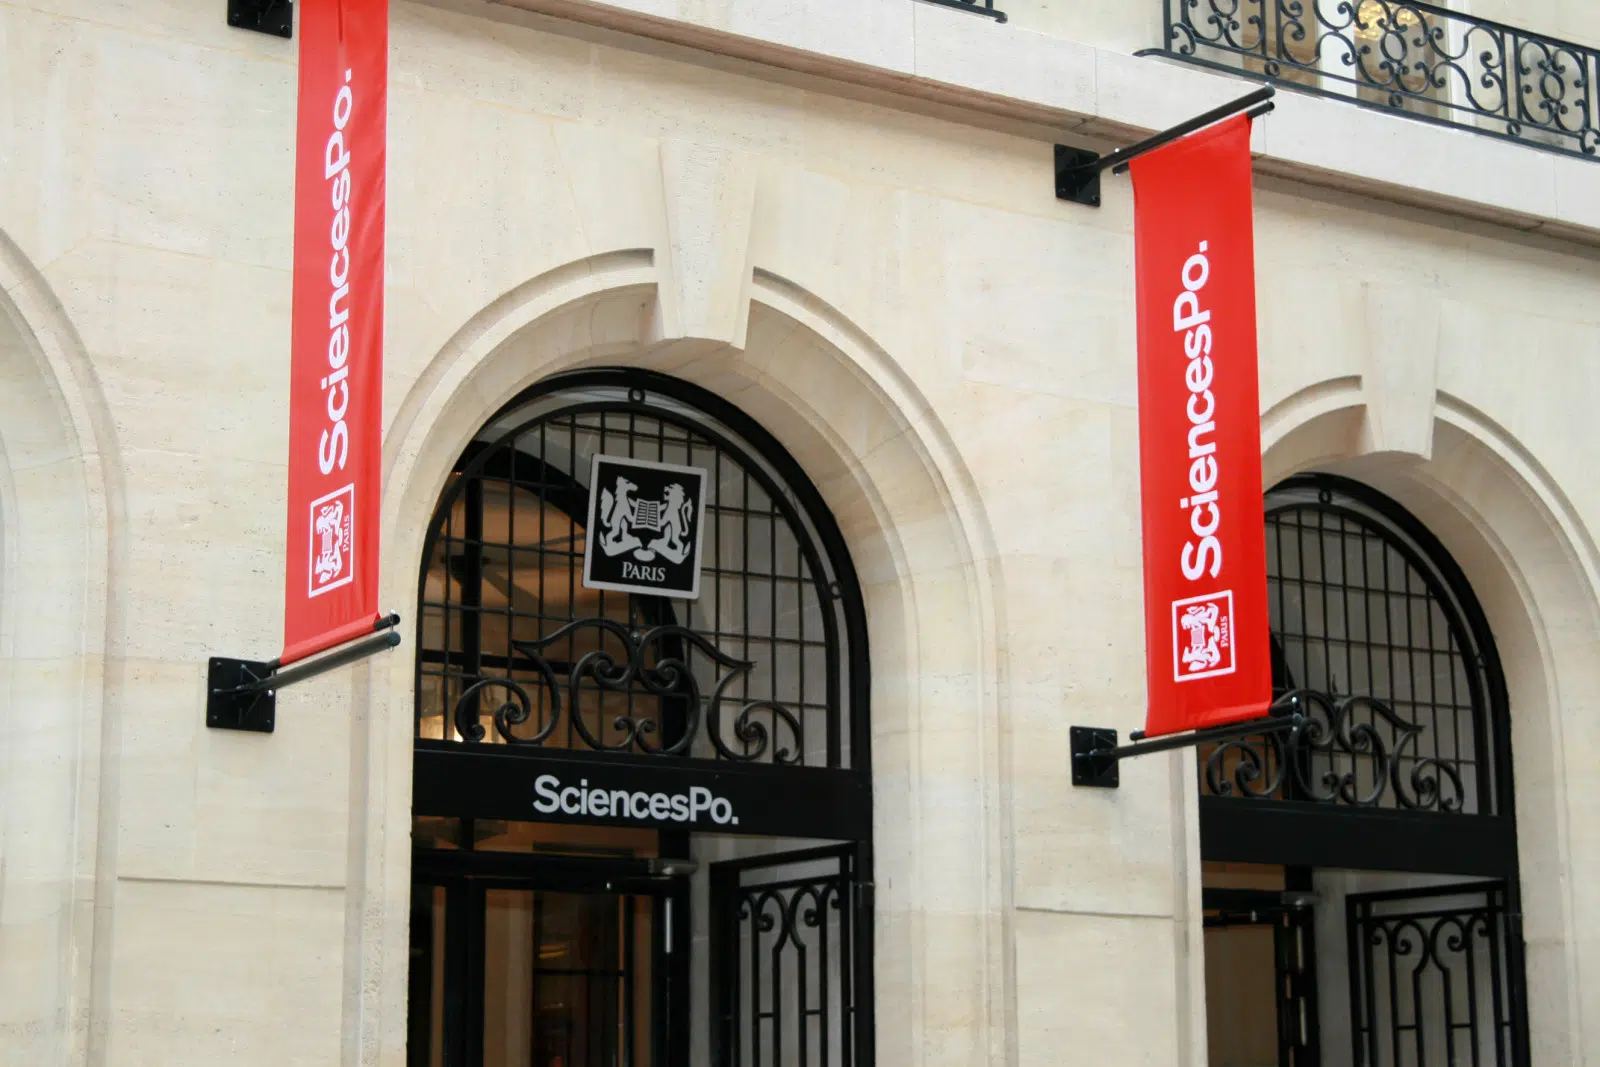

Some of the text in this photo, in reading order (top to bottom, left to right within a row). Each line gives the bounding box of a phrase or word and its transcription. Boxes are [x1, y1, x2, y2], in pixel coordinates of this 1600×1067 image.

[318, 69, 354, 476] SciencesPo.
[1173, 240, 1222, 581] SciencesPo.
[342, 514, 350, 553] PARIS
[621, 561, 666, 582] PARIS
[1220, 615, 1229, 648] PARIS
[532, 774, 739, 825] SciencesPo.
